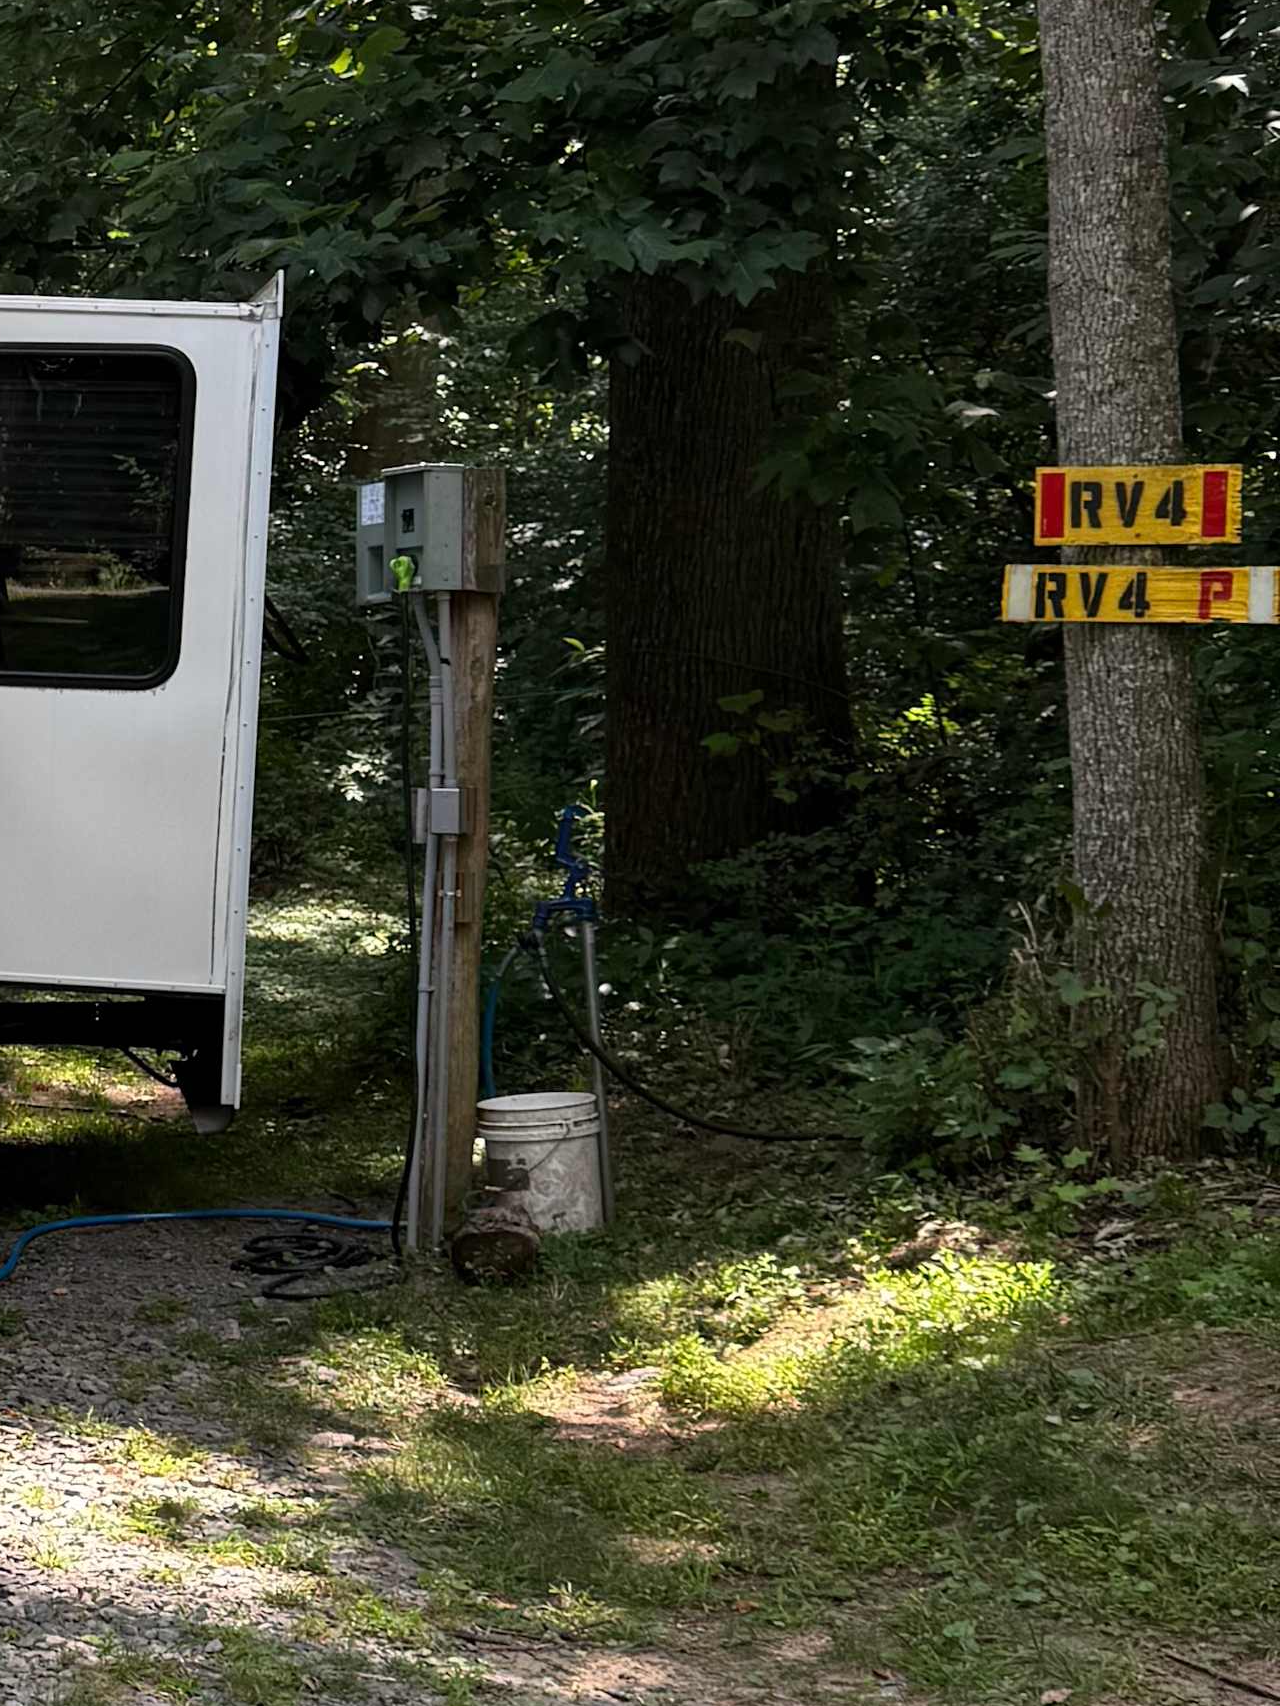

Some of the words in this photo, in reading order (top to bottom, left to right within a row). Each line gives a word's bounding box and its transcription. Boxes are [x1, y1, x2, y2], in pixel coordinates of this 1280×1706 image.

[1070, 480, 1188, 529] RV4
[1035, 572, 1151, 619] RV4
[1198, 570, 1234, 620] P
